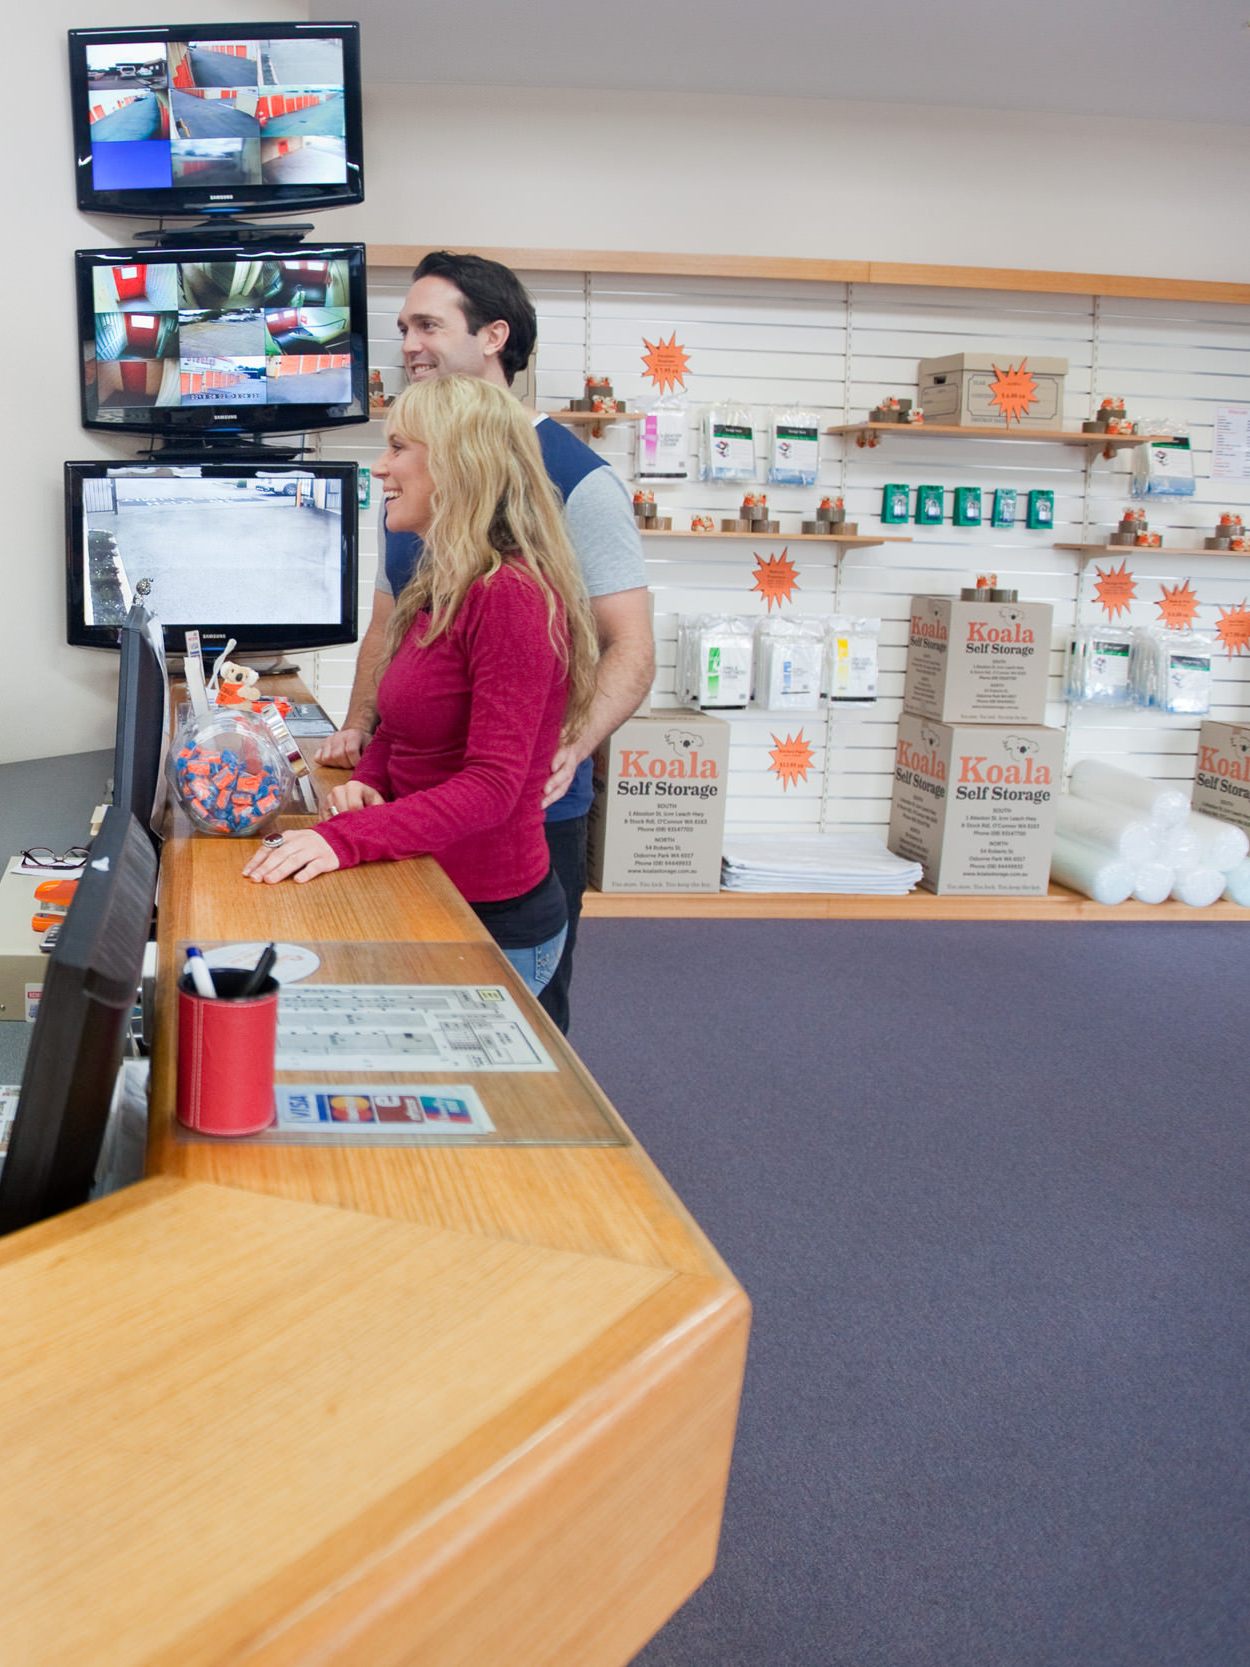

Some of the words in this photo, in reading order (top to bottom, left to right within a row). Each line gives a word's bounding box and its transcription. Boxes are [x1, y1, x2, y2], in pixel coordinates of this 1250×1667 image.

[911, 615, 947, 640] Koala
[966, 622, 1035, 643] Koala
[966, 642, 990, 654] Self
[991, 643, 1034, 657] Storage
[617, 750, 720, 779] Koala
[897, 739, 947, 781] Koala
[957, 756, 1052, 785] Koala
[1198, 745, 1250, 782] Koal
[617, 780, 652, 796] Self
[655, 780, 718, 800] Storage
[895, 768, 913, 783] Self
[913, 774, 946, 799] Storage
[956, 785, 989, 800] Self
[991, 786, 1051, 805] Storage
[1197, 772, 1219, 790] Self
[1220, 779, 1250, 799] Stora
[290, 1095, 312, 1119] VISA
